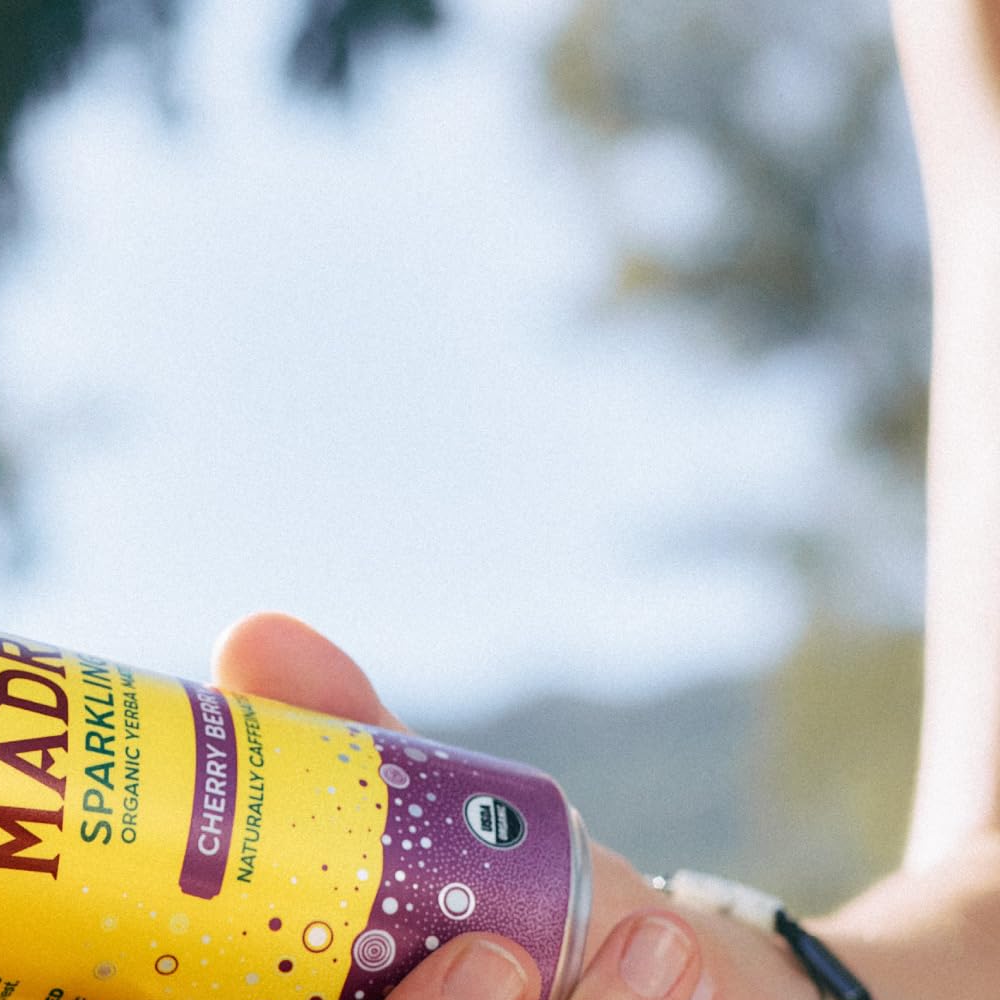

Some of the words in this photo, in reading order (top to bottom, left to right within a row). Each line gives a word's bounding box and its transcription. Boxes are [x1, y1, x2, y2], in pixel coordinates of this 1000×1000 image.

[122, 692, 142, 745] YERBA
[120, 746, 142, 844] ORGANIC
[197, 744, 229, 856] CHERRY
[236, 770, 265, 884] NATURALLY
